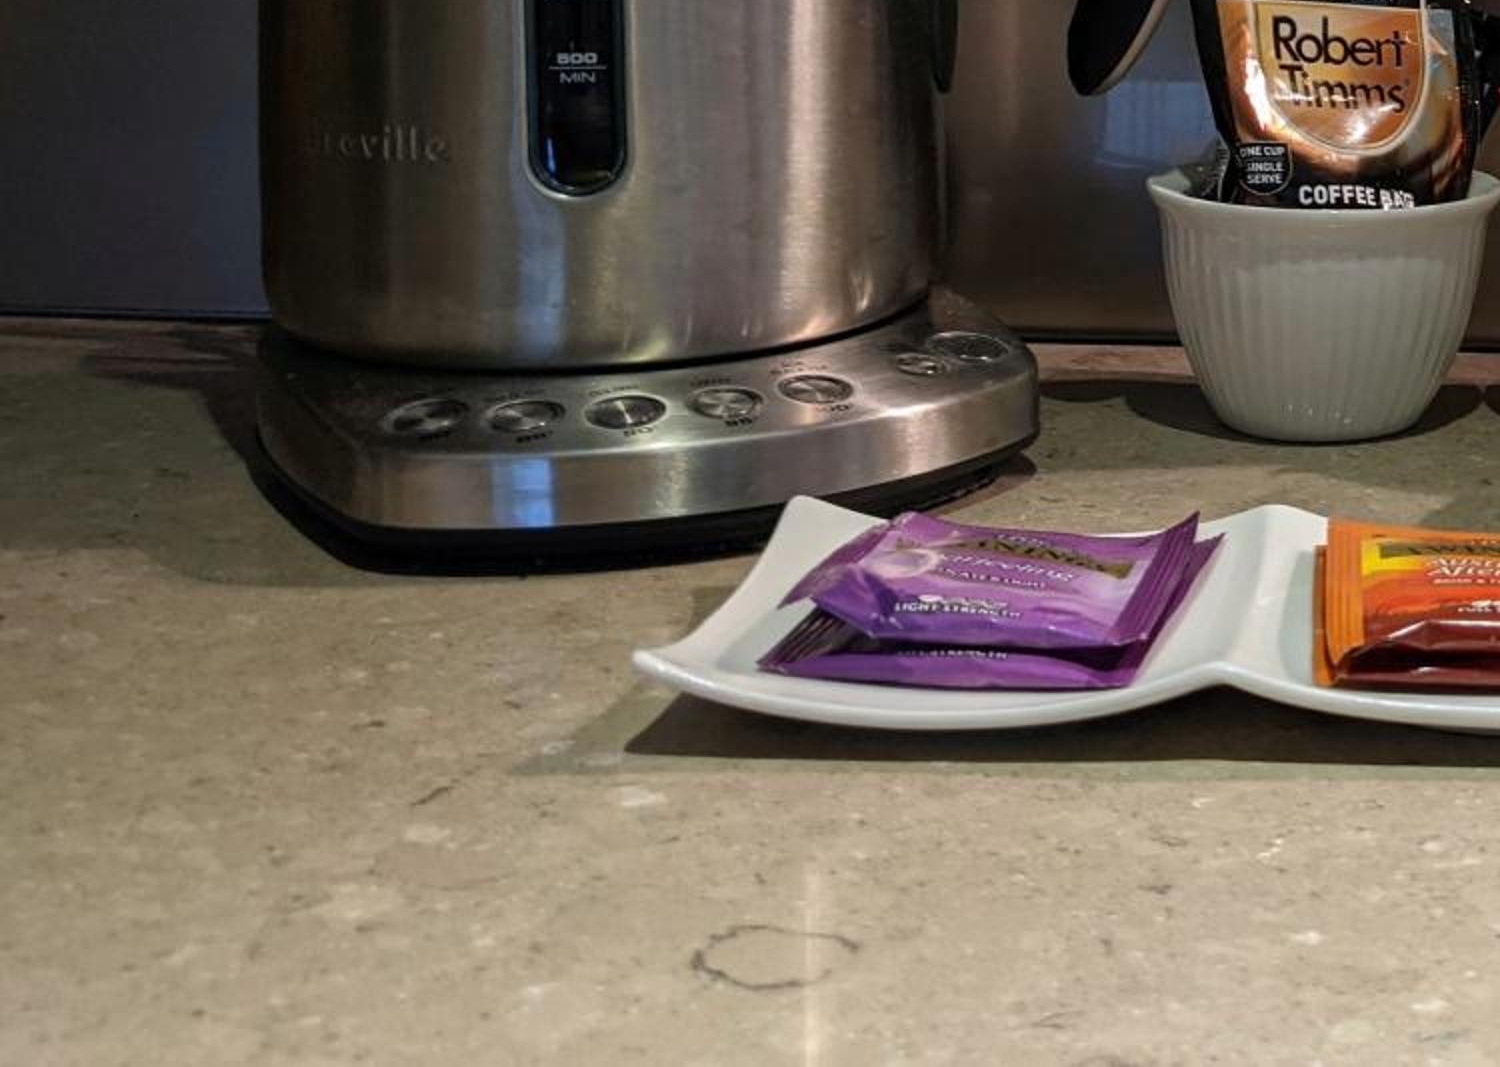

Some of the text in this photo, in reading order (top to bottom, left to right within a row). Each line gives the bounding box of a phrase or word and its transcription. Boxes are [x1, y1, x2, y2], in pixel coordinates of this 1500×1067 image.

[1272, 15, 1406, 68] Robert
[557, 52, 598, 64] 500
[559, 72, 596, 84] MIN
[1279, 64, 1406, 113] Timms
[305, 122, 447, 163] reville
[1239, 146, 1285, 157] ONE CUP
[1246, 173, 1283, 184] SERVE
[1299, 184, 1376, 207] COFFEE
